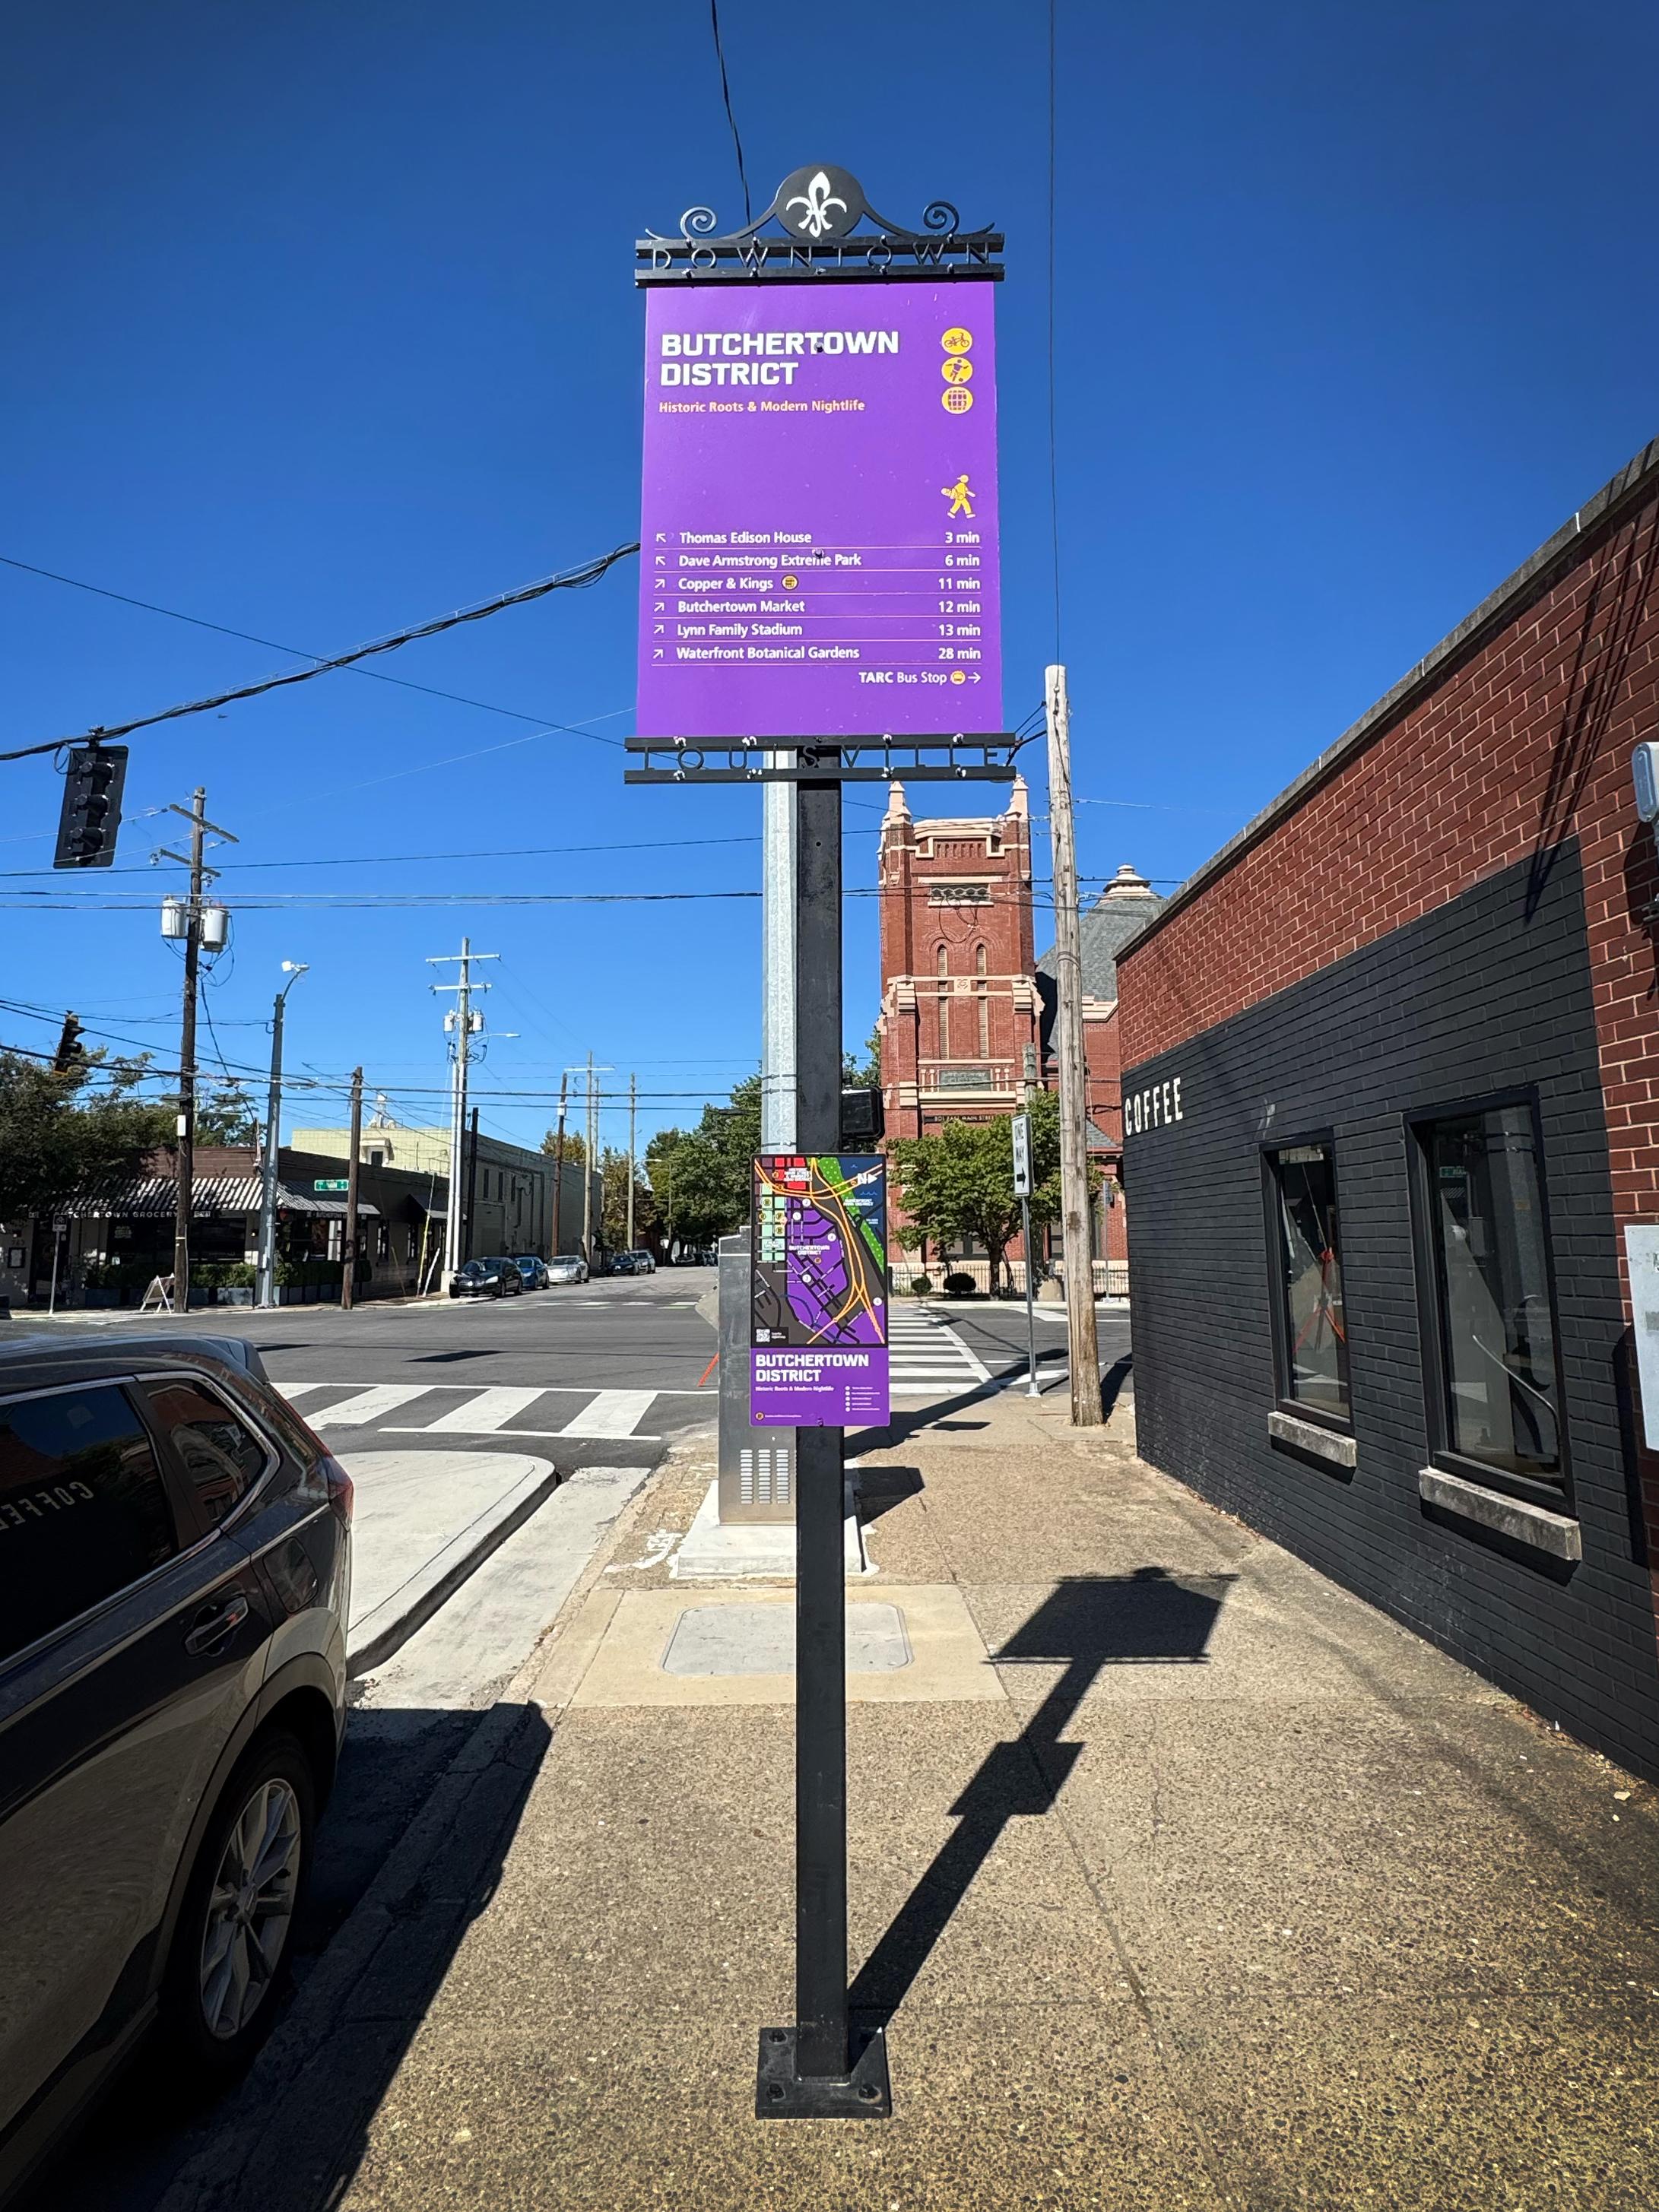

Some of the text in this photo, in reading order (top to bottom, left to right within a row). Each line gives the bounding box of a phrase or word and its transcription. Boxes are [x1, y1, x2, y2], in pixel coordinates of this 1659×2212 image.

[652, 242, 989, 269] DOWNTOWN
[661, 331, 898, 356] BUTCHERTOWN
[661, 362, 798, 385] DISTRICT
[659, 400, 864, 414] Historic Roots & Modern Nightlife
[680, 531, 811, 543] Thomas Edison House
[945, 531, 979, 543] 3 min
[679, 553, 861, 569] Dave Armstrong Extreme Park
[945, 554, 979, 566] 6 min
[678, 577, 773, 592] Copper & Kings
[939, 577, 980, 589] 11 min
[678, 600, 804, 613] Butchertown Market
[939, 601, 980, 613] 12 min
[677, 623, 802, 639] Lynn Family Stadium
[939, 624, 980, 635] 13 min
[677, 646, 859, 659] Waterfront Botanical Gardens
[939, 648, 981, 659] 28 min
[858, 672, 947, 685] TARC Bus Stop
[644, 746, 998, 769] LOUISVILLE
[1125, 1076, 1183, 1136] COFFEE
[1014, 1123, 1024, 1141] ONE
[1016, 1146, 1025, 1163] WAY
[757, 1355, 868, 1366] BUTCHERTOWN
[757, 1370, 821, 1381] DISTRICT
